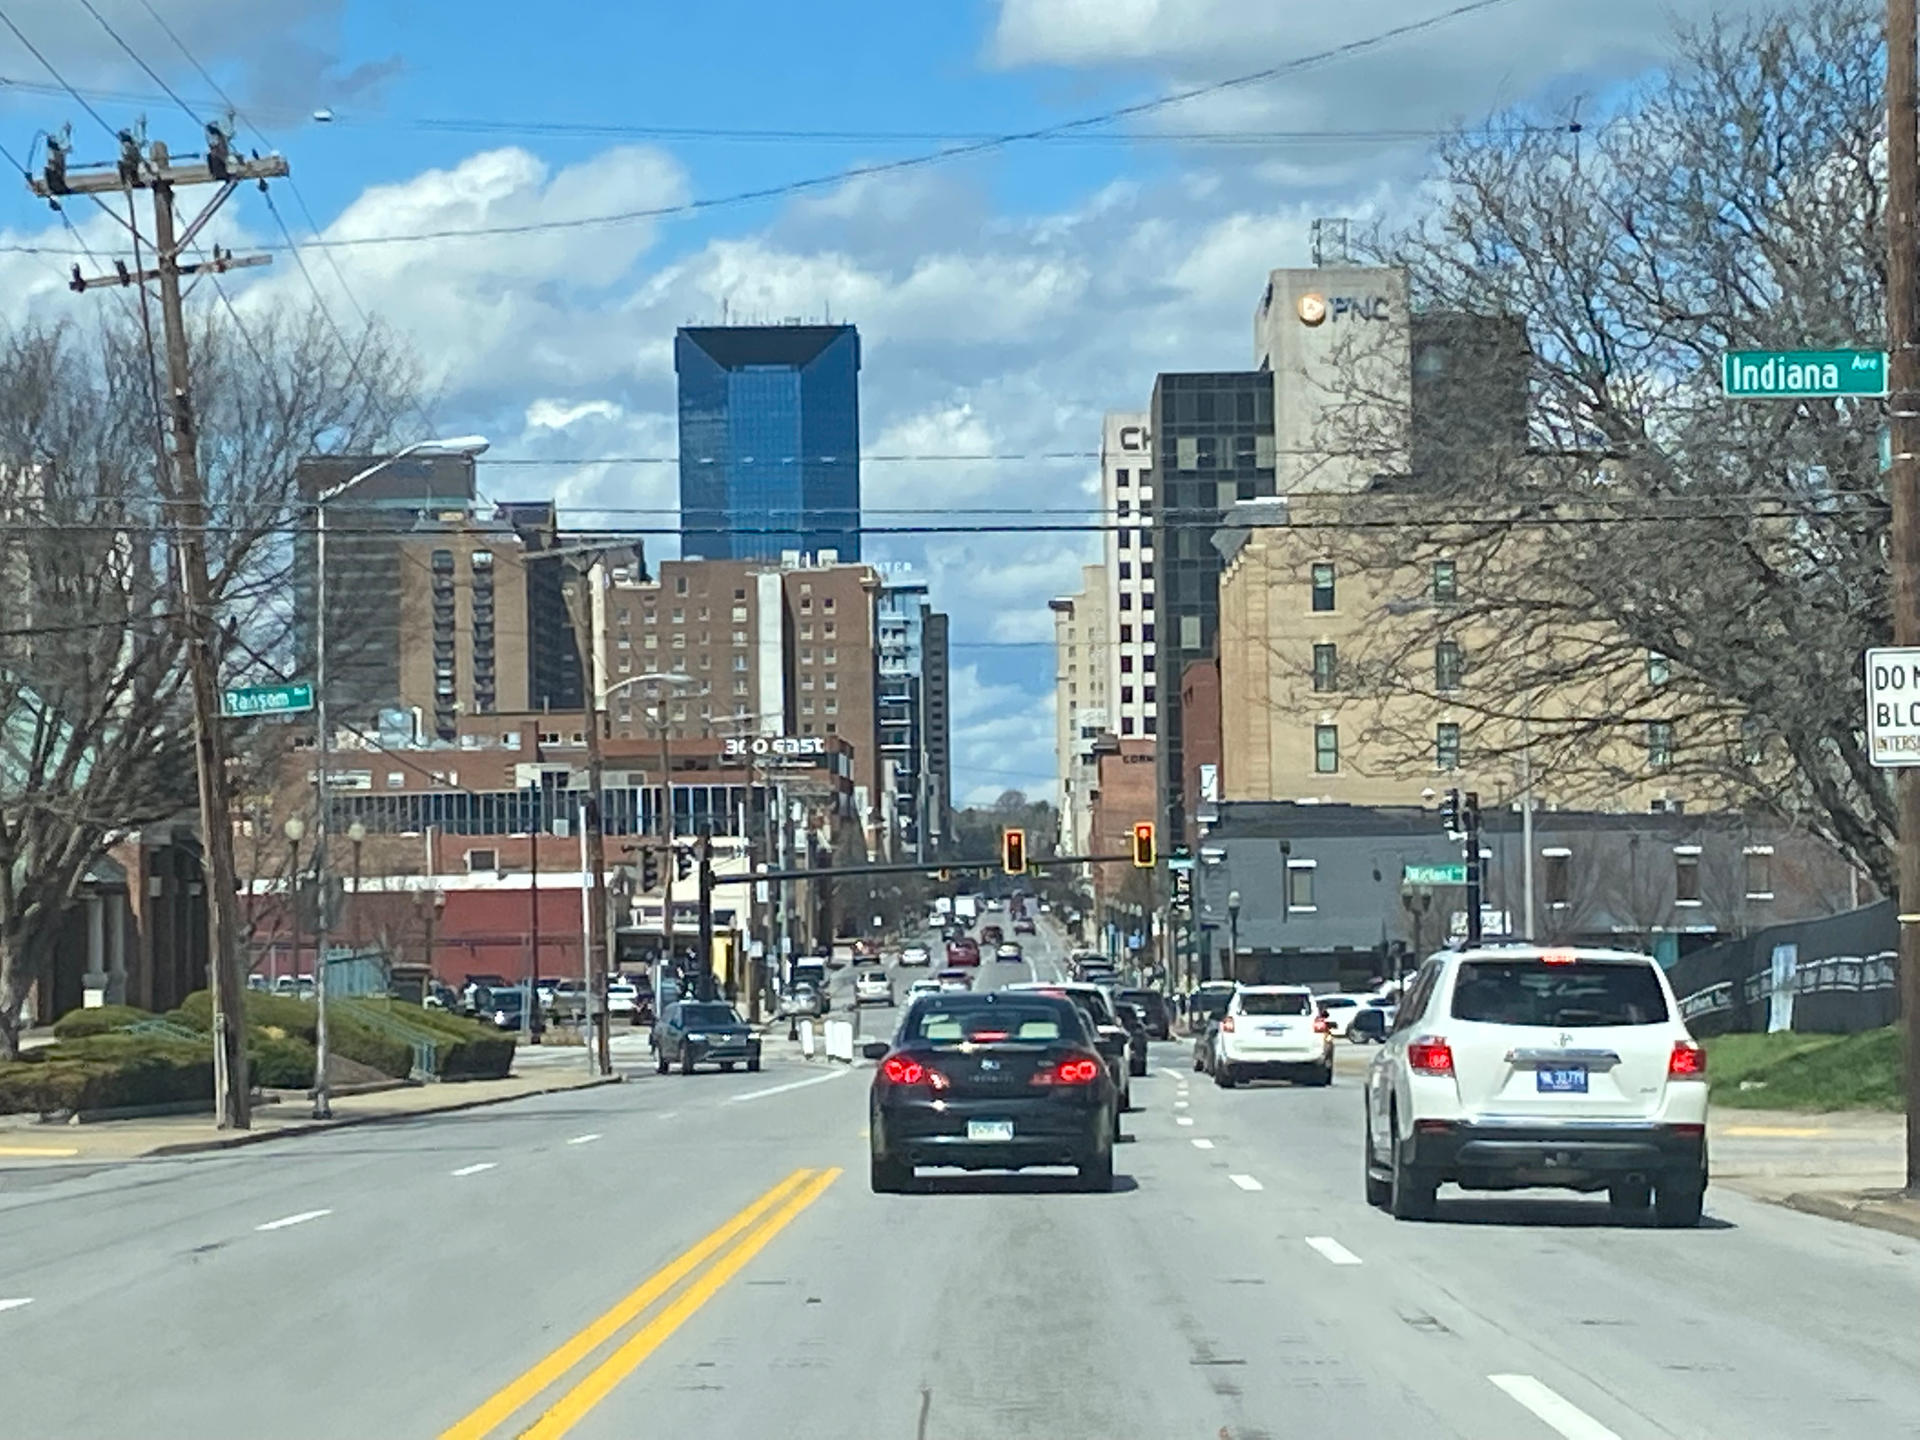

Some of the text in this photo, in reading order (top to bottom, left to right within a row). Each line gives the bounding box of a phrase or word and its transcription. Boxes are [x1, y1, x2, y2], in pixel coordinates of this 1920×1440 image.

[1330, 296, 1389, 322] PNC
[1733, 355, 1878, 391] Indiana Ave
[1875, 665, 1906, 690] DO
